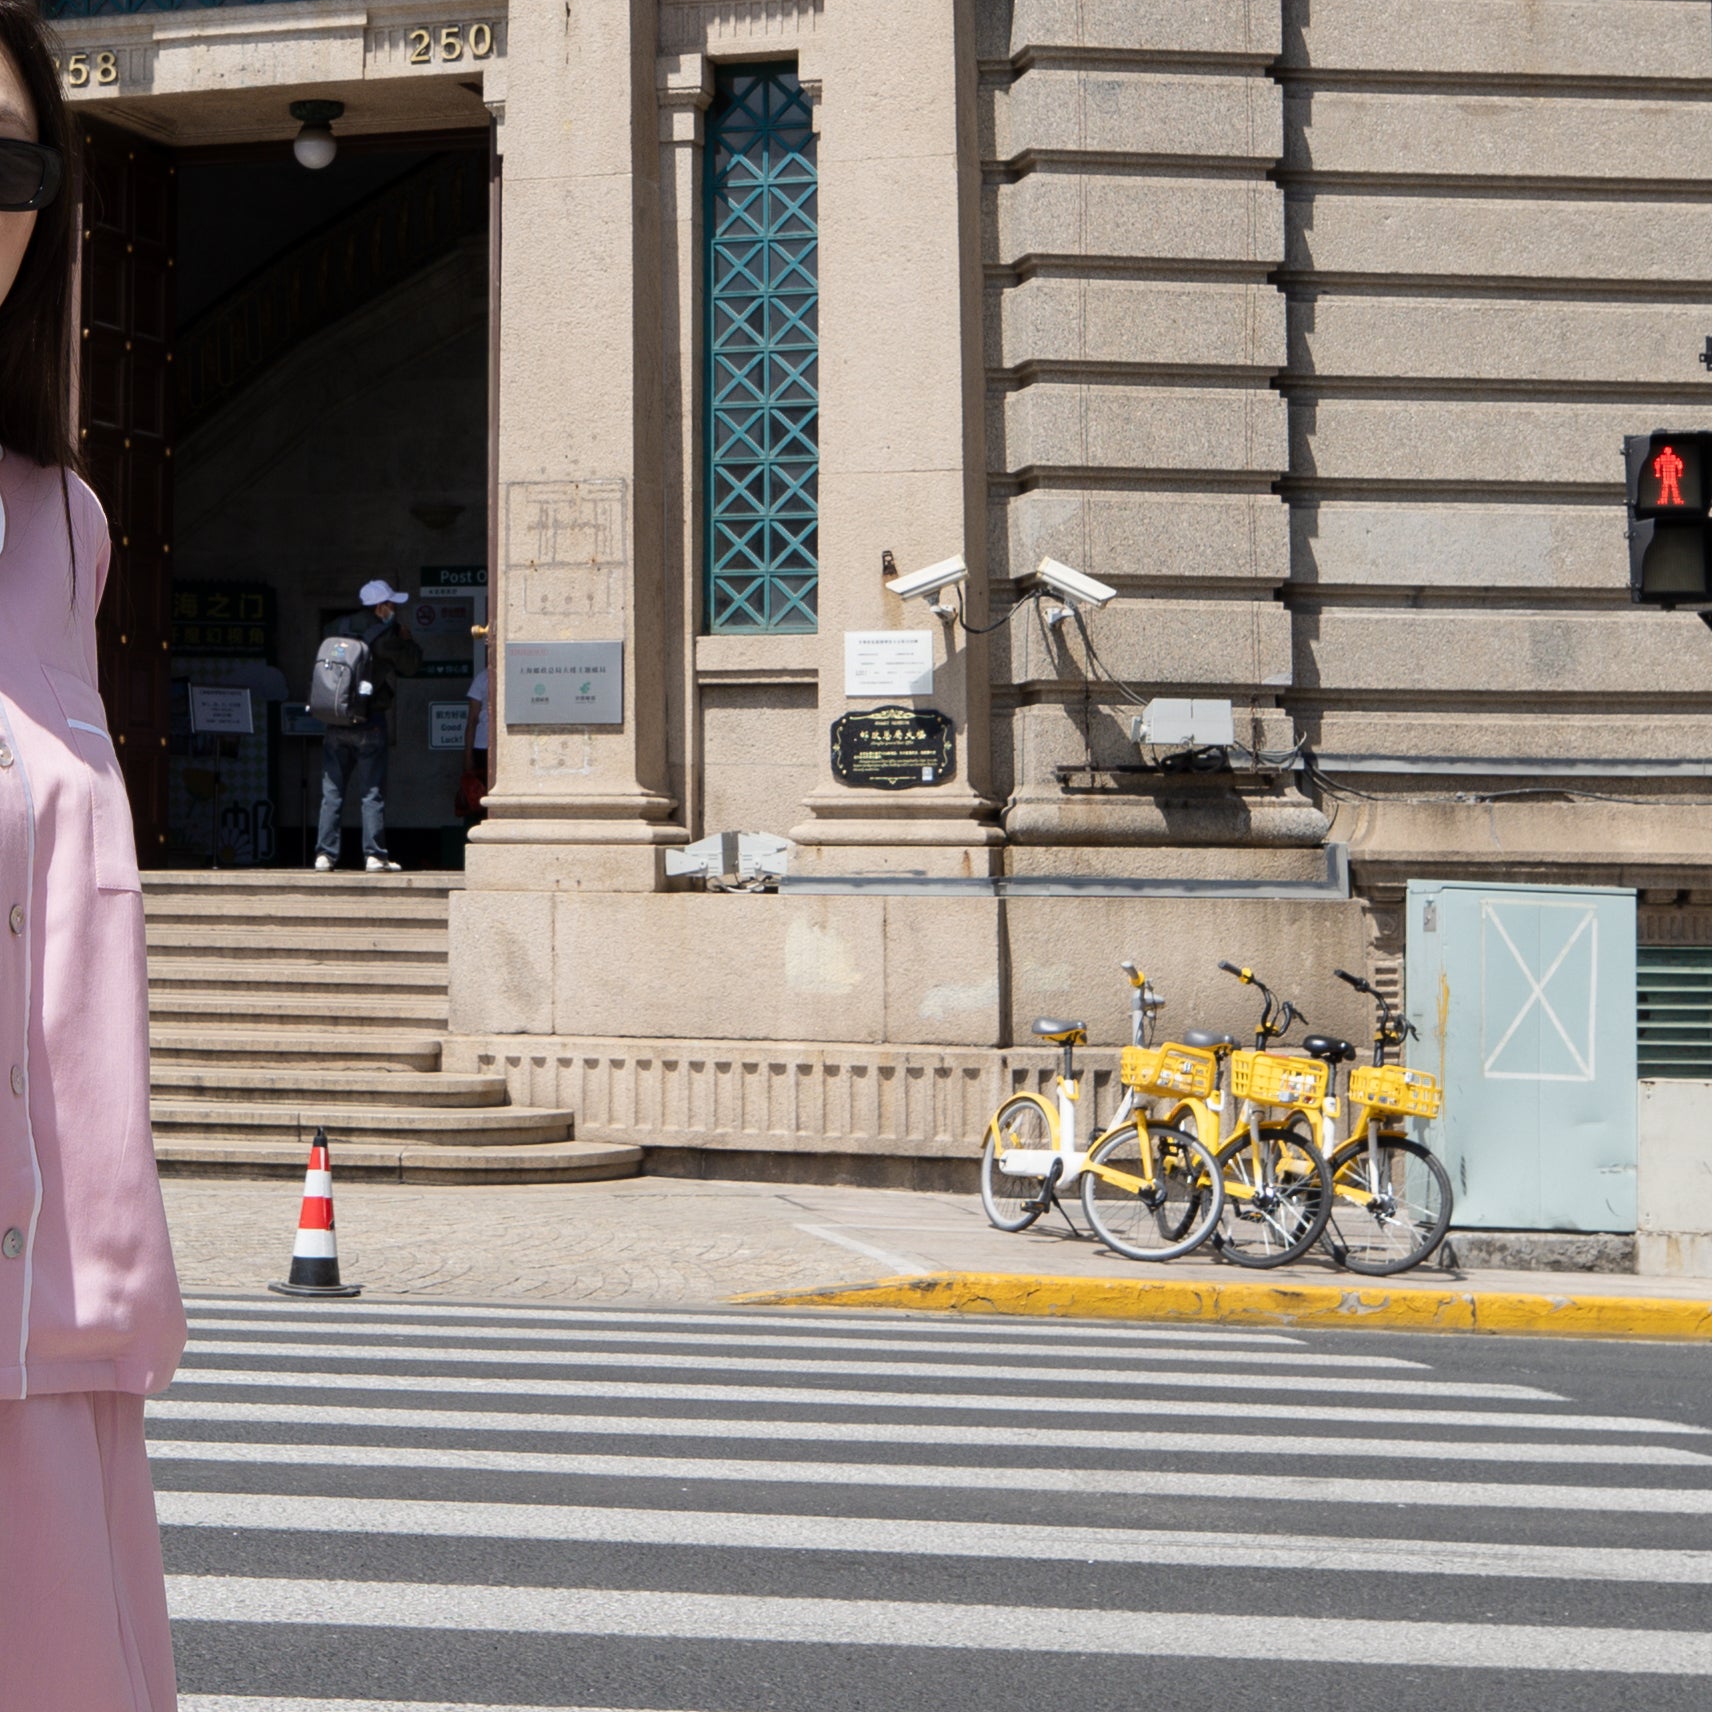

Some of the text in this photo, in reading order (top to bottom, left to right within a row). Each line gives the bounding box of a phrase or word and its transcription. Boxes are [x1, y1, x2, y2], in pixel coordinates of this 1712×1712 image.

[409, 23, 493, 64] 250
[55, 50, 117, 86] 58
[440, 570, 472, 584] Post
[441, 723, 462, 731] Good
